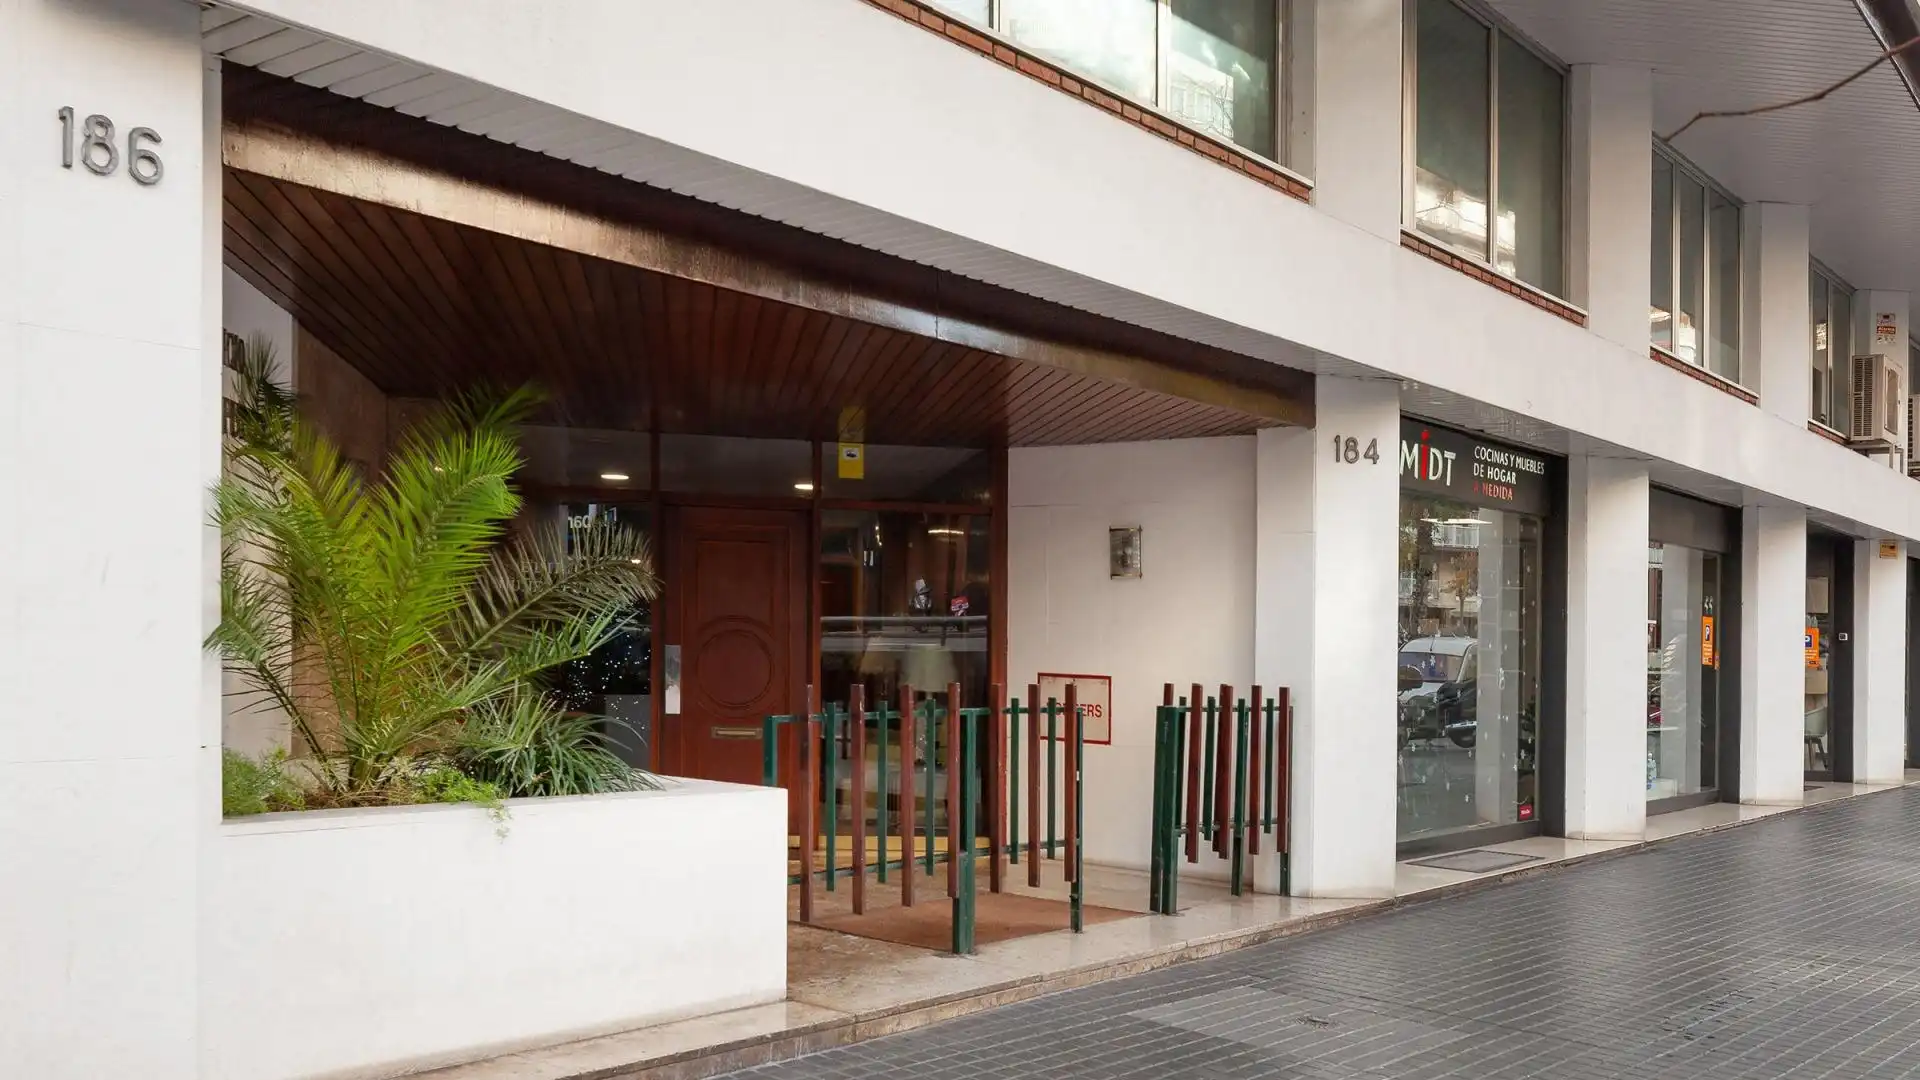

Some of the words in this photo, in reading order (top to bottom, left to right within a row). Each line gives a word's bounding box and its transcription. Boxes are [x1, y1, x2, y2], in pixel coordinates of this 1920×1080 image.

[58, 105, 164, 185] 186
[1334, 434, 1380, 465] 184
[1474, 445, 1508, 466] COCINAS
[1509, 453, 1515, 466] Y
[1515, 456, 1545, 475] MUEBLES
[1473, 462, 1485, 478] DE
[1487, 466, 1517, 485] HOGAR
[1482, 483, 1513, 501] MEDIDA
